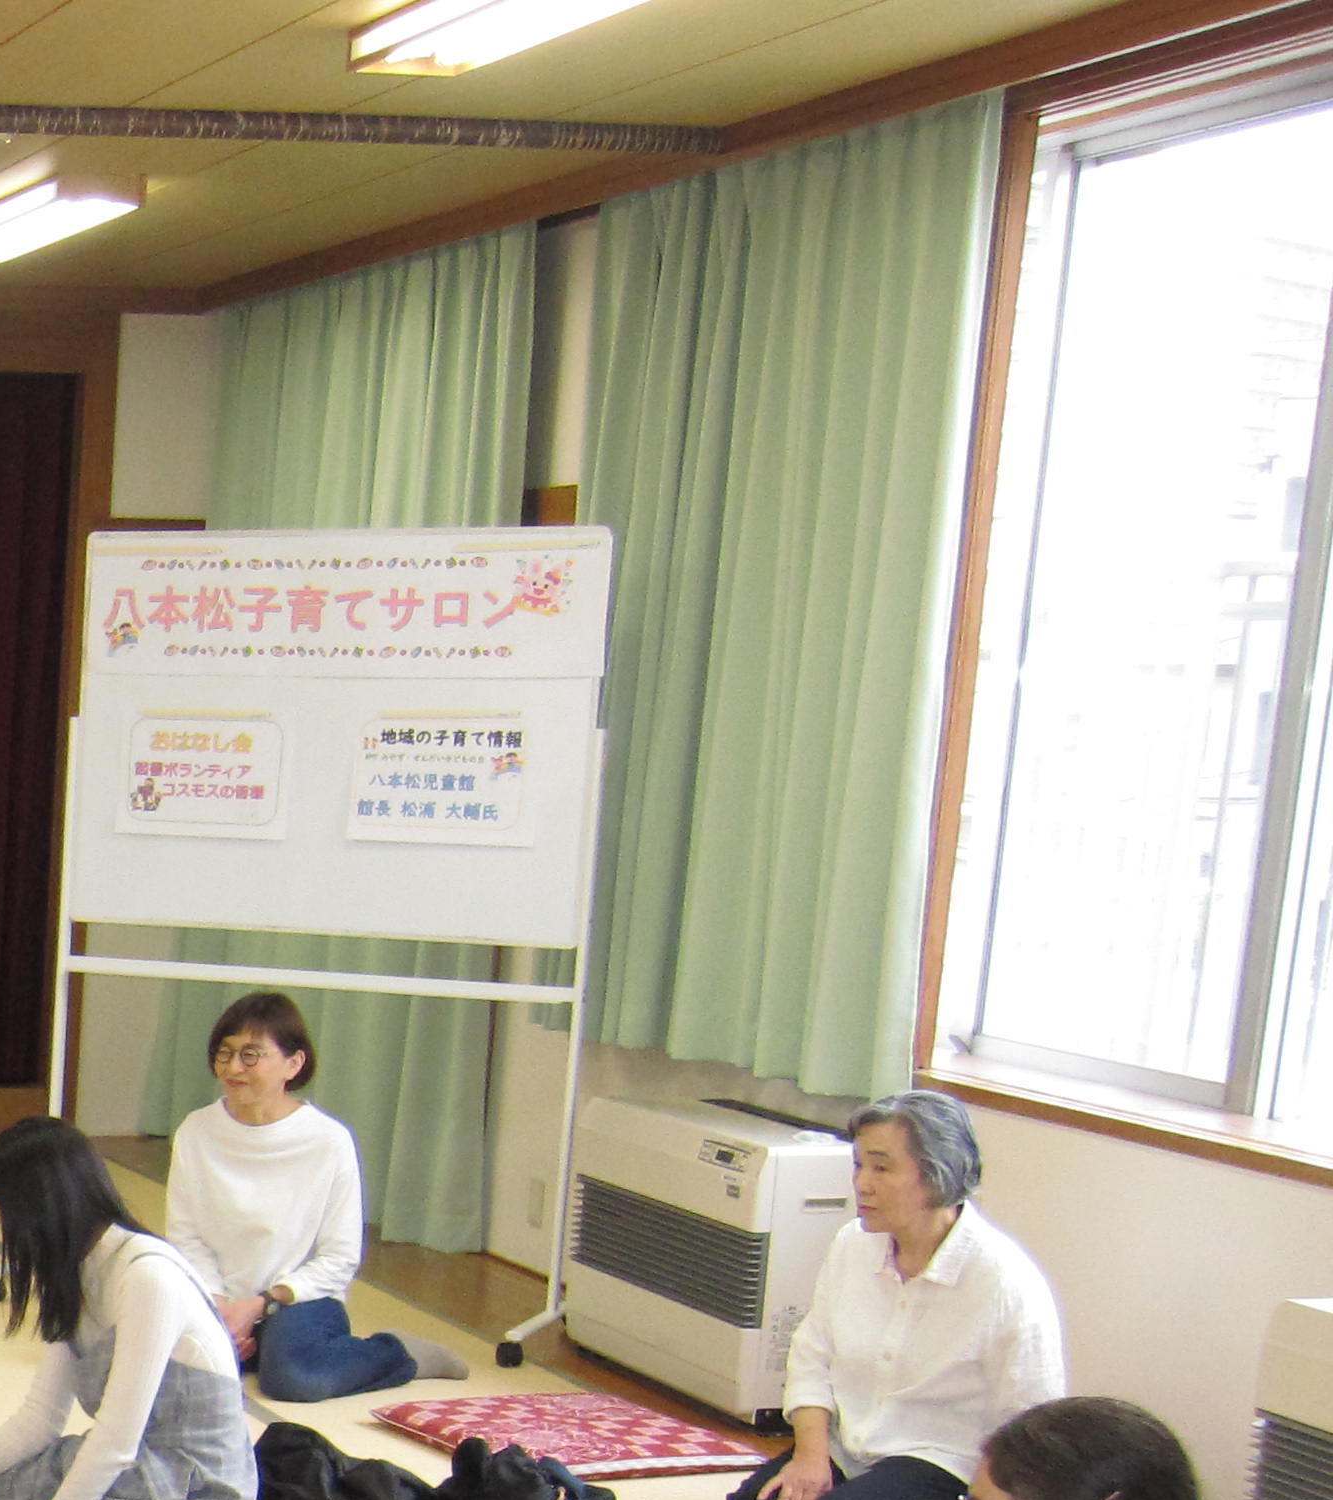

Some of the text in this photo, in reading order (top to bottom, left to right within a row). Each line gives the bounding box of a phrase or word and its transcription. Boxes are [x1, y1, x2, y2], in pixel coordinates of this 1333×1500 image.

[103, 585, 517, 633] 八本松子育てサロン
[149, 729, 255, 754] おはなし会
[380, 727, 523, 749] 地域の子育て情報
[368, 773, 477, 792] 八本松児童館
[356, 799, 392, 817] 館長
[400, 801, 437, 819] 松浦
